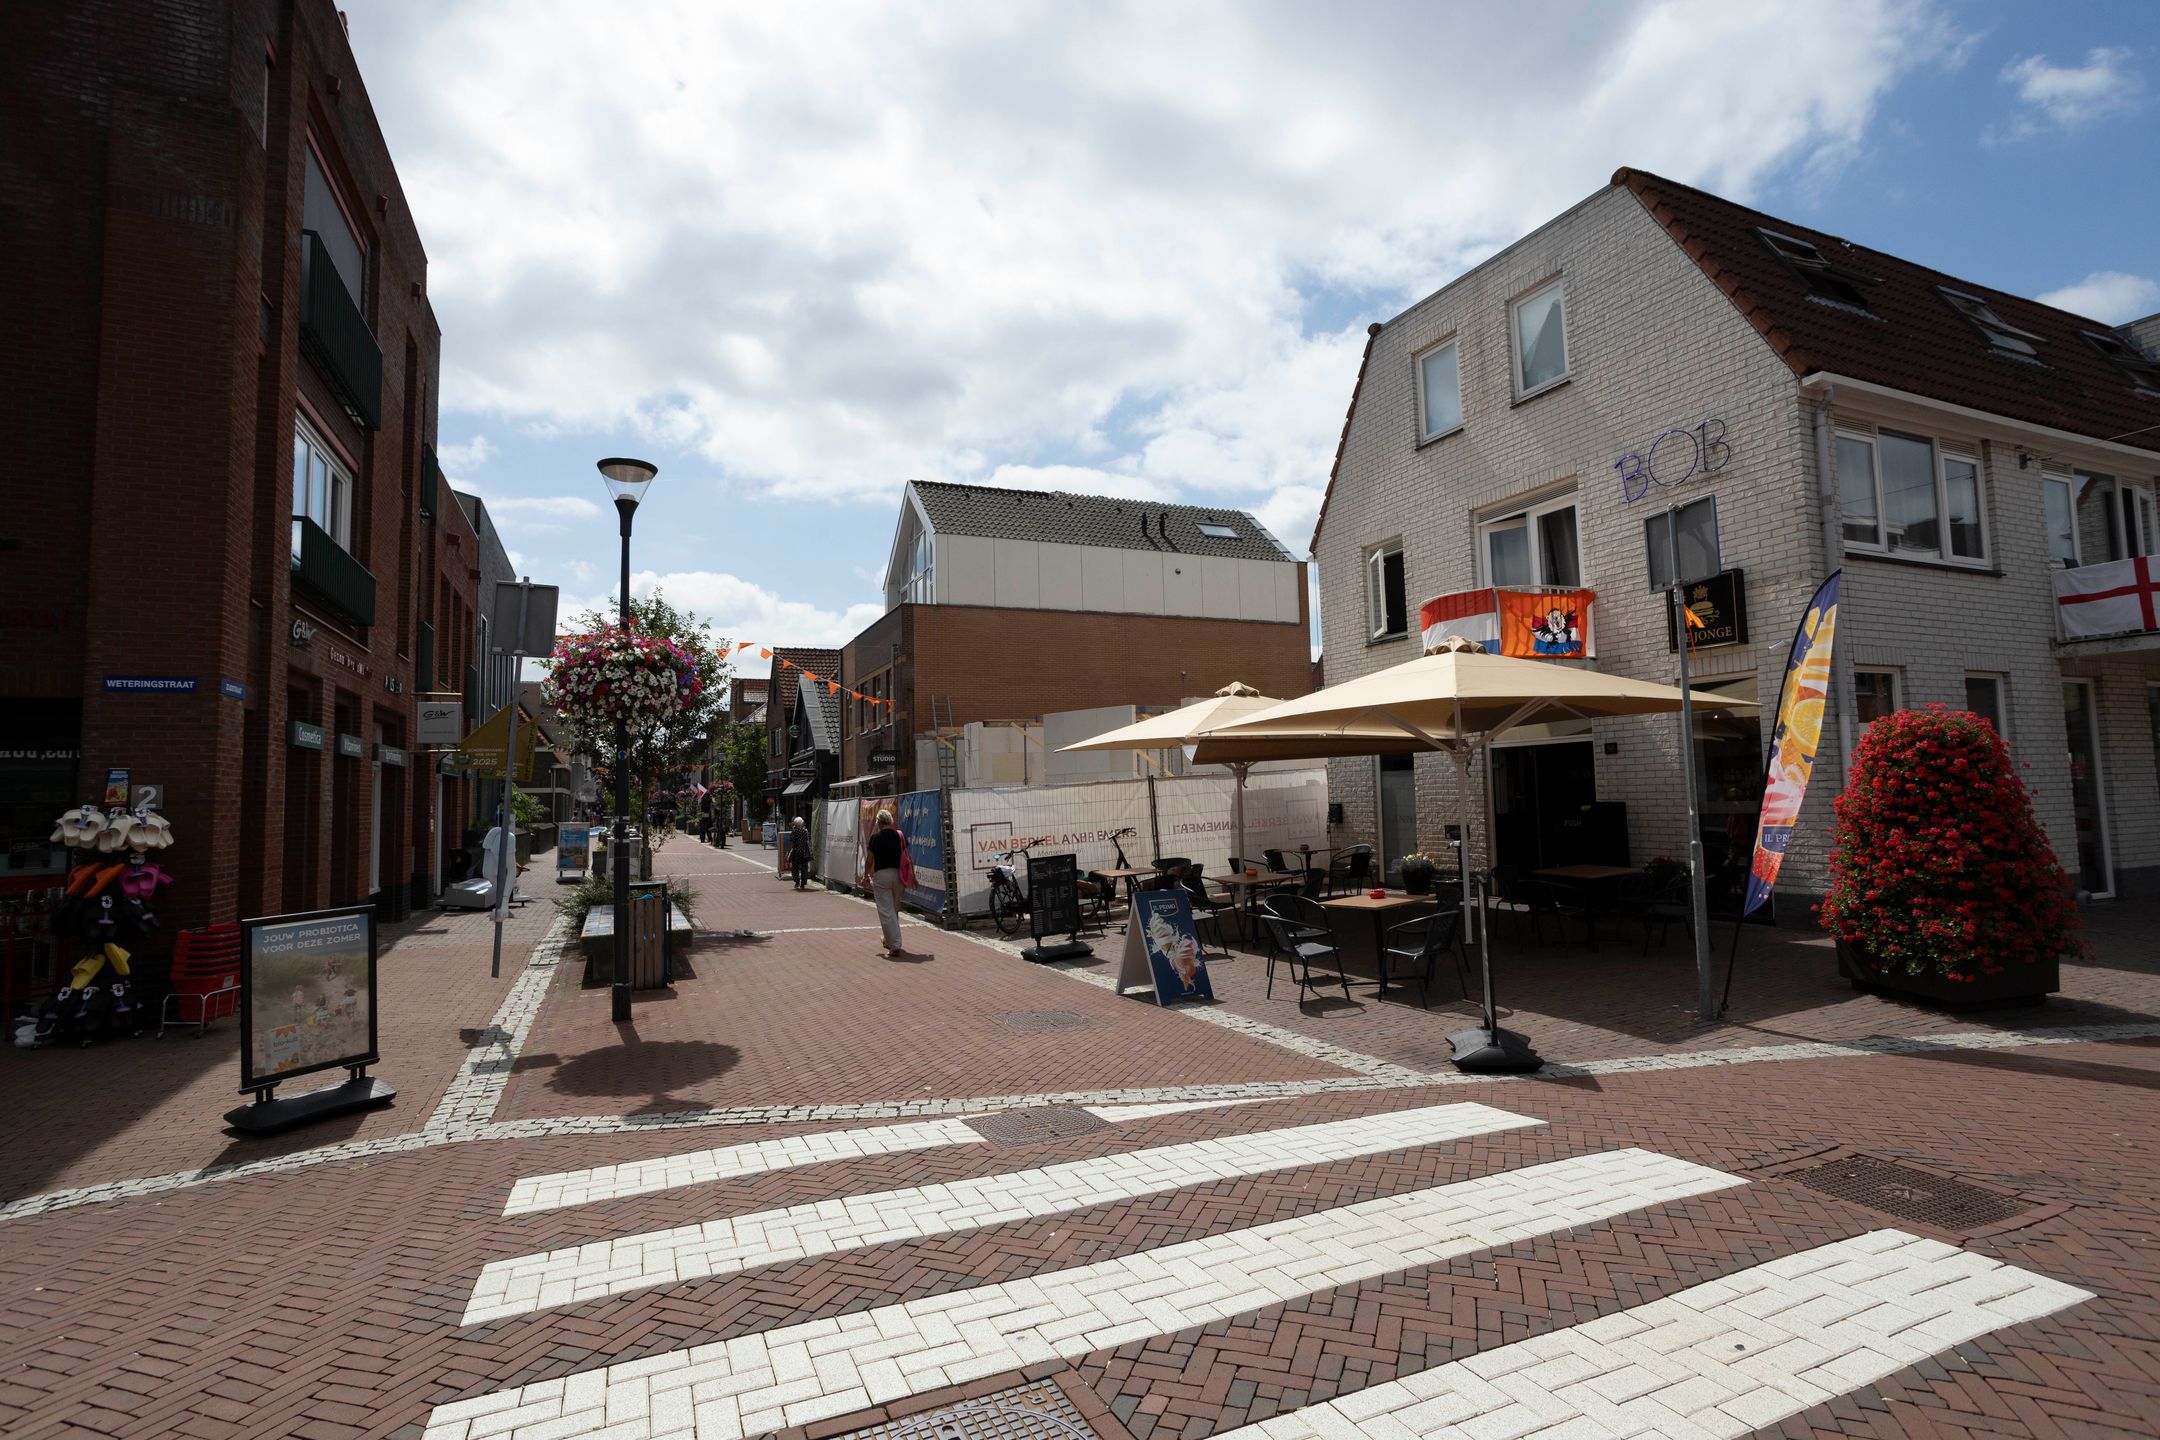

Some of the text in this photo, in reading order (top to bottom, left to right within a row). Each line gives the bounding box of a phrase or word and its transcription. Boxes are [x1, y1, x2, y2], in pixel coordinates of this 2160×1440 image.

[1614, 418, 1730, 504] BOB
[1694, 626, 1733, 643] JONGE
[106, 679, 194, 689] WETERINGSTRAAT
[423, 710, 456, 720] G&W
[472, 758, 498, 766] 2025
[137, 786, 157, 809] 2
[1764, 833, 1774, 843] IL
[978, 840, 1007, 851] VAN
[264, 923, 359, 943] JOUW PROBIOTICA
[262, 933, 361, 954] VOOR DEZE ZOMER
